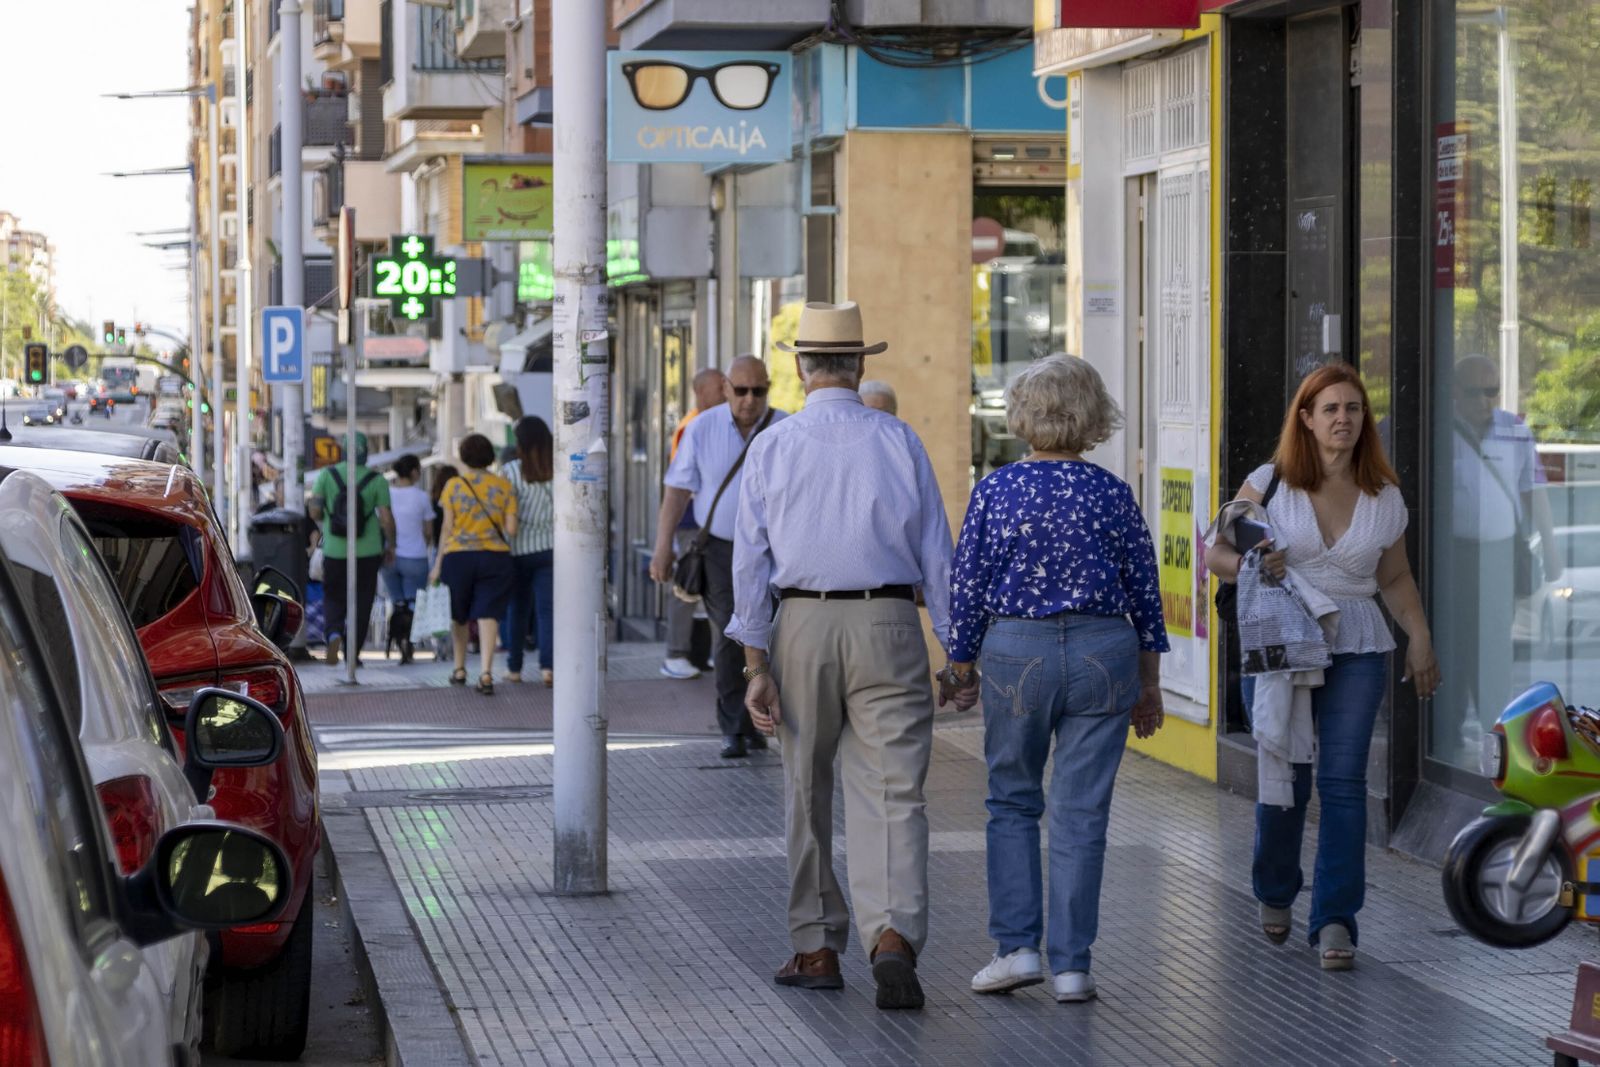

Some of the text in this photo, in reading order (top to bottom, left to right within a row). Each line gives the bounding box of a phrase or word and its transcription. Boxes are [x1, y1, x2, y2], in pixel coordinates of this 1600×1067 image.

[270, 315, 295, 374] P
[1164, 533, 1191, 570] EN ORO
